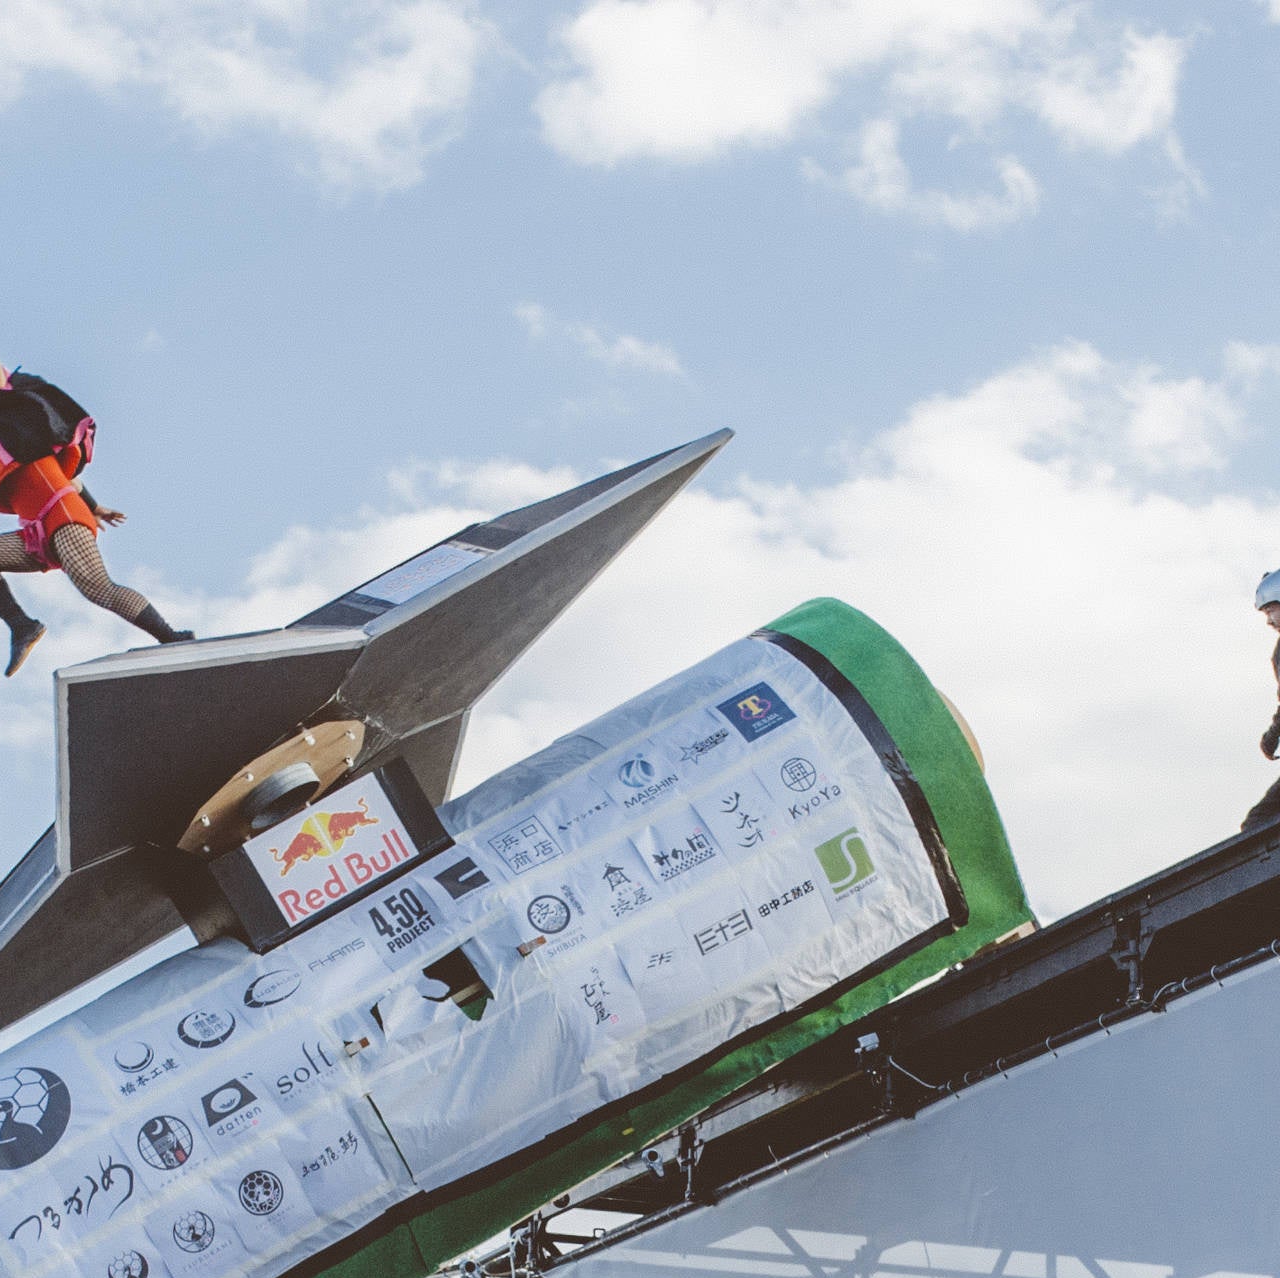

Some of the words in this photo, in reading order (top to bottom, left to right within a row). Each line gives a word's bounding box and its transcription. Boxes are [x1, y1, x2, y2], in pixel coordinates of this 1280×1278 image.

[624, 774, 679, 808] MAISHIN
[788, 784, 841, 820] KyoYa
[278, 864, 348, 922] Red
[343, 828, 410, 885] Bull
[758, 880, 815, 917] 田中工務店
[386, 914, 435, 953] PROJECT
[546, 933, 587, 957] SHIBUYA
[216, 1105, 262, 1136] datten
